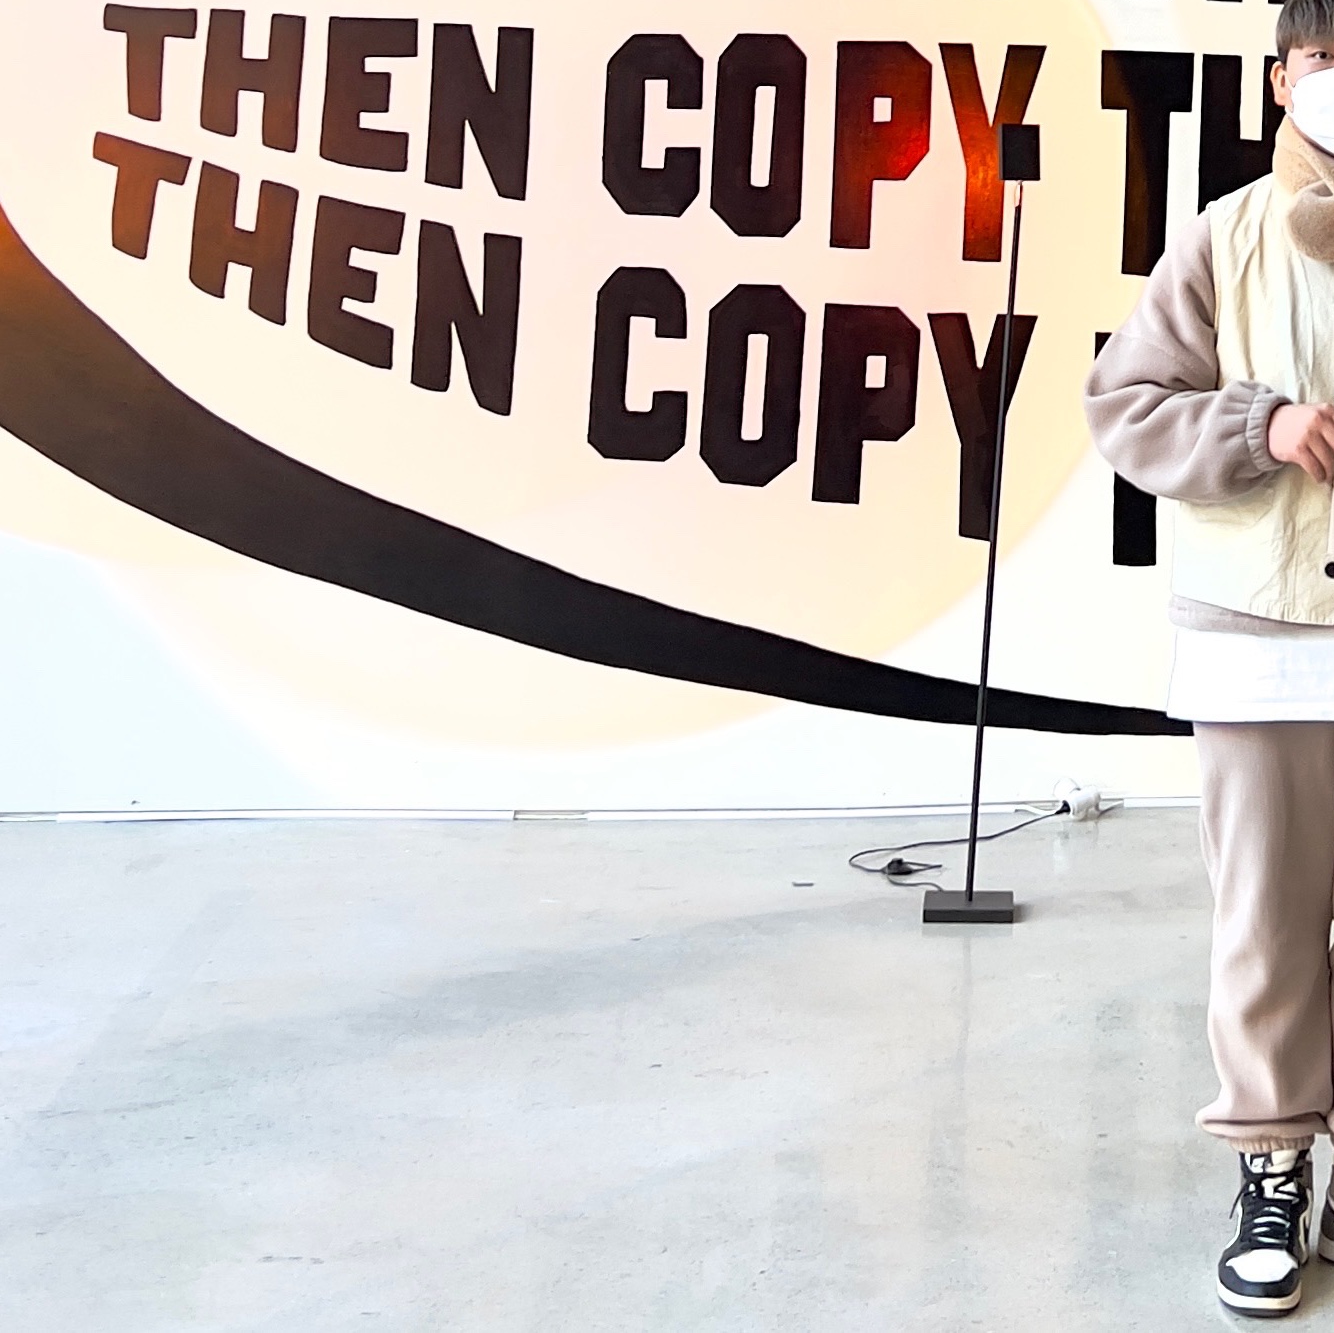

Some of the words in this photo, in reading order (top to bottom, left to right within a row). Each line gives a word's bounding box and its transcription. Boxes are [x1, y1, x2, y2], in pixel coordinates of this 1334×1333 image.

[103, 3, 534, 201] THEN
[602, 33, 1047, 262] COPY
[92, 131, 522, 416] THEN
[588, 266, 1039, 542] COPY
